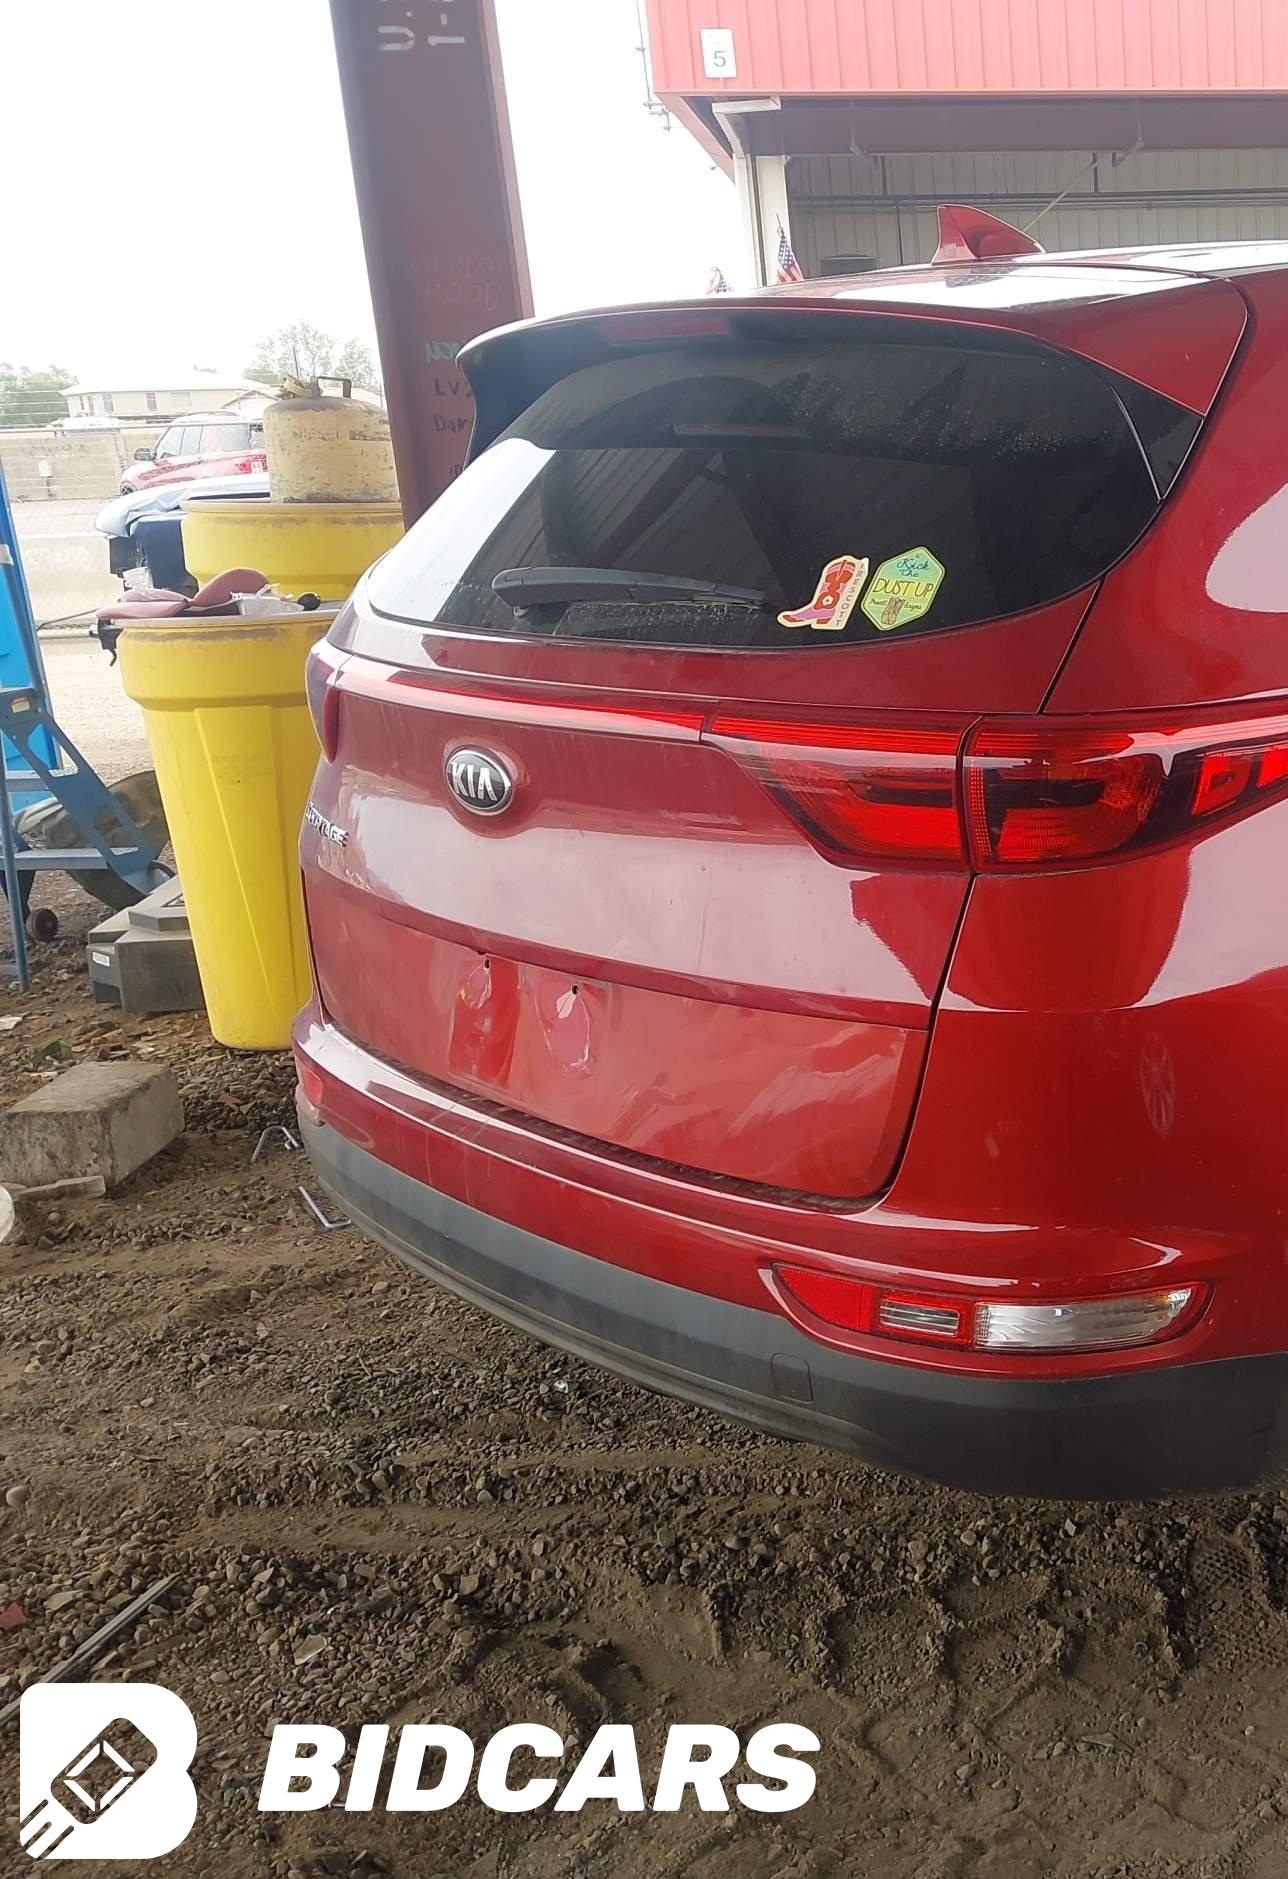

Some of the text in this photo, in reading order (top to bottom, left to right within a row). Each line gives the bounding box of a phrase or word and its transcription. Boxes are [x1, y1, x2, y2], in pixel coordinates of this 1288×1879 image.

[713, 49, 728, 68] 5
[873, 578, 934, 598] DUST UP
[450, 762, 498, 802] KIA
